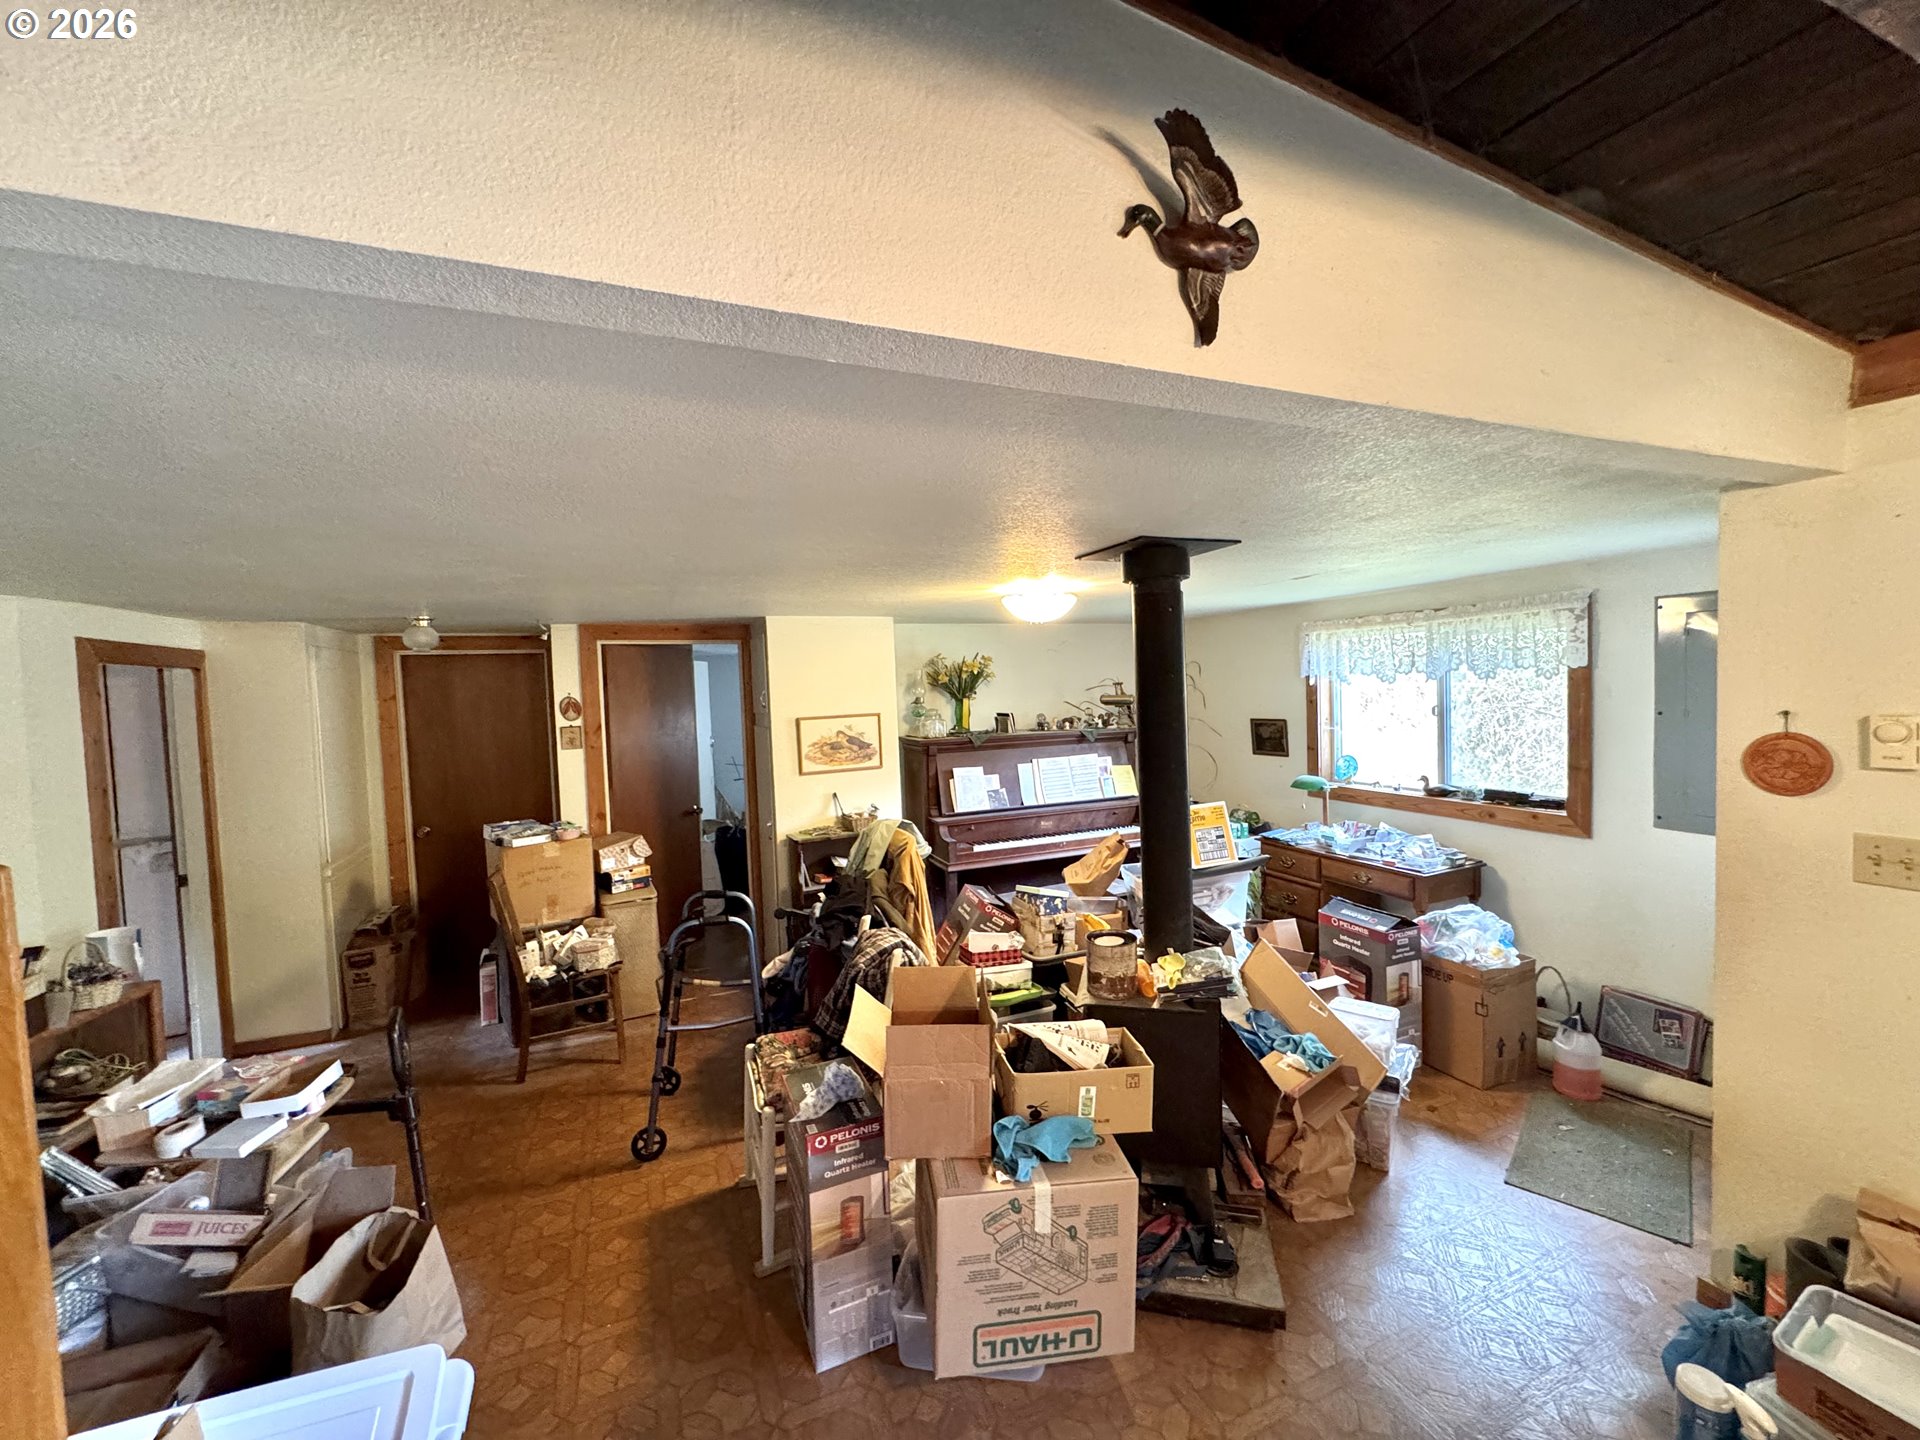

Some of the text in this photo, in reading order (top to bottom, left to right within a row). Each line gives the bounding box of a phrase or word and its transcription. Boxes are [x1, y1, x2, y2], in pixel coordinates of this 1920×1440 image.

[1339, 921, 1369, 935] PELONIS
[1332, 939, 1371, 956] Quartz Heater
[1339, 934, 1361, 946] Infrared
[1442, 972, 1454, 983] UP
[829, 1122, 880, 1143] PELONIS
[833, 1152, 864, 1167] Infrared
[824, 1158, 876, 1179] Quartz Heater
[194, 1221, 249, 1237] JUICES
[997, 1299, 1078, 1317] Loading Your Truck
[981, 1327, 1093, 1359] U-HAUL
